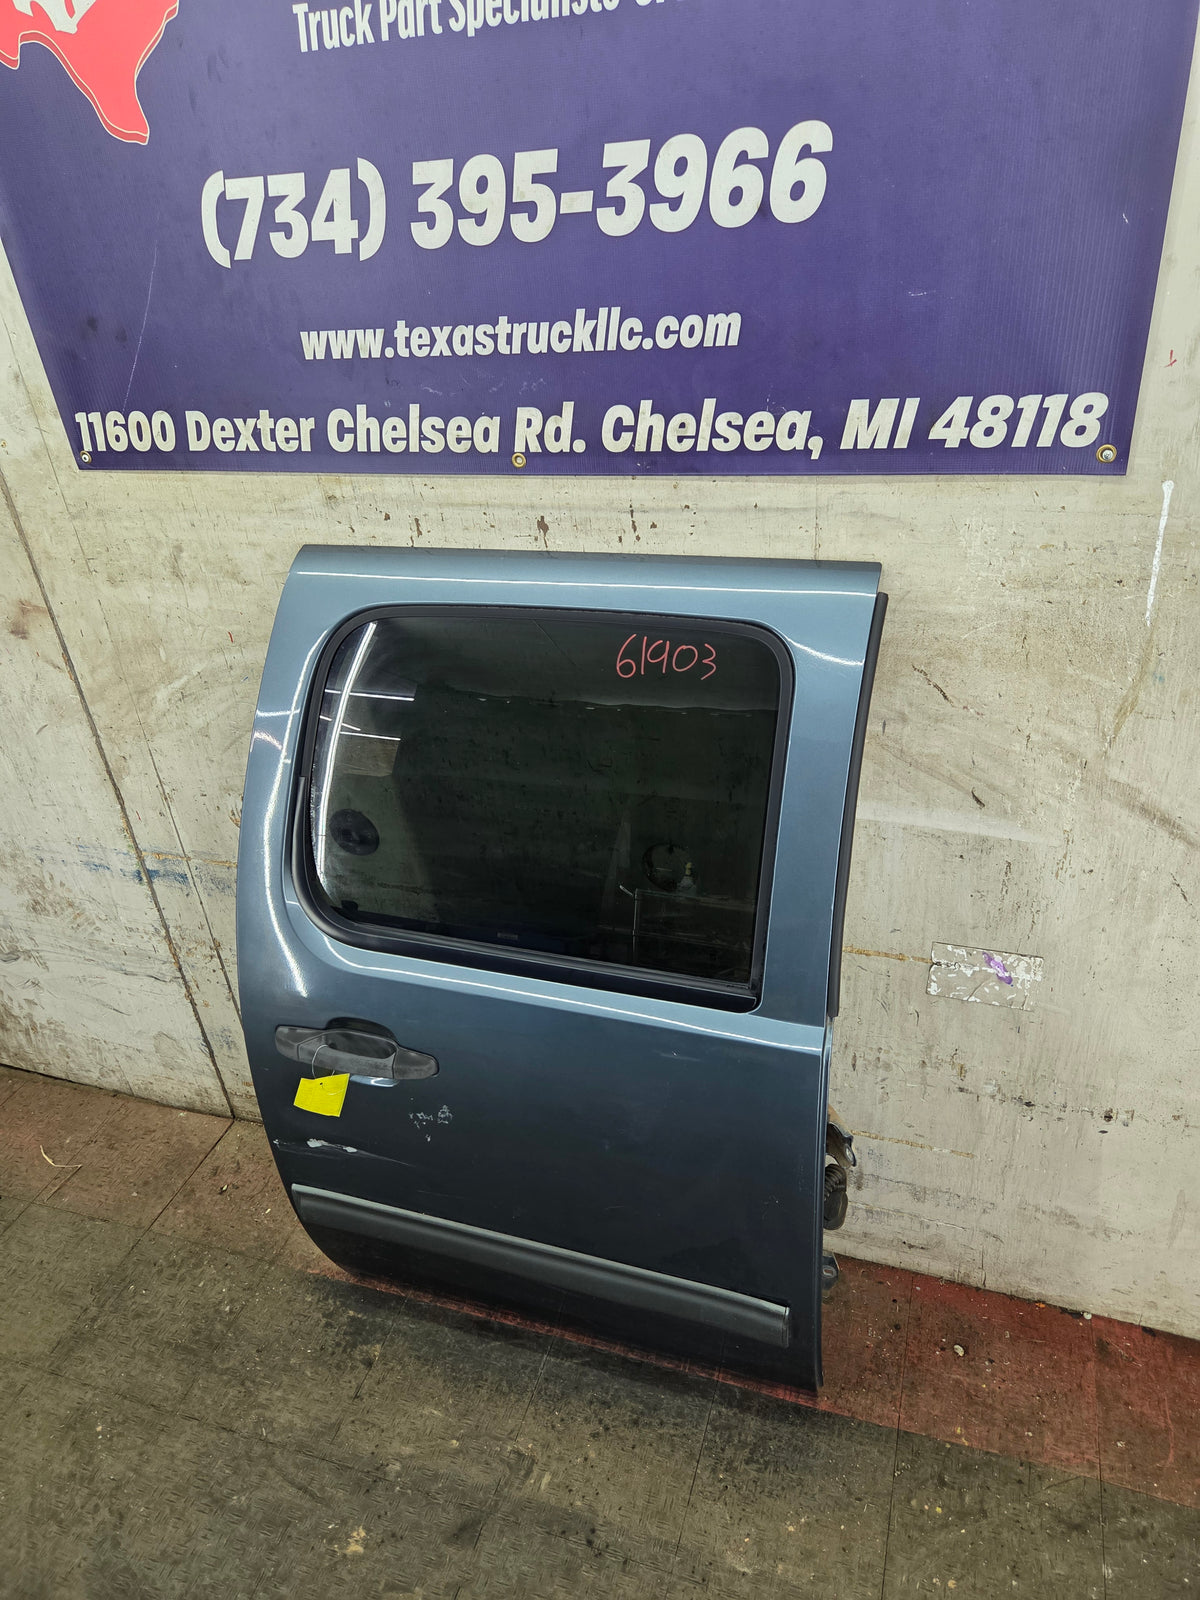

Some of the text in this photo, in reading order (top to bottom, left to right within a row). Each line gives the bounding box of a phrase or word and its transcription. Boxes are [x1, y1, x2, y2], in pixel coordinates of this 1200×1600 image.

[290, 0, 376, 53] Truck
[378, 0, 443, 43] Part
[200, 119, 834, 269] (734) 395-3966
[300, 306, 742, 361] www.texastruckllc.com
[74, 391, 1109, 460] 11600 Dexter Chelsea Rd. Chelsea, MI 48118
[616, 633, 717, 680] 61903
